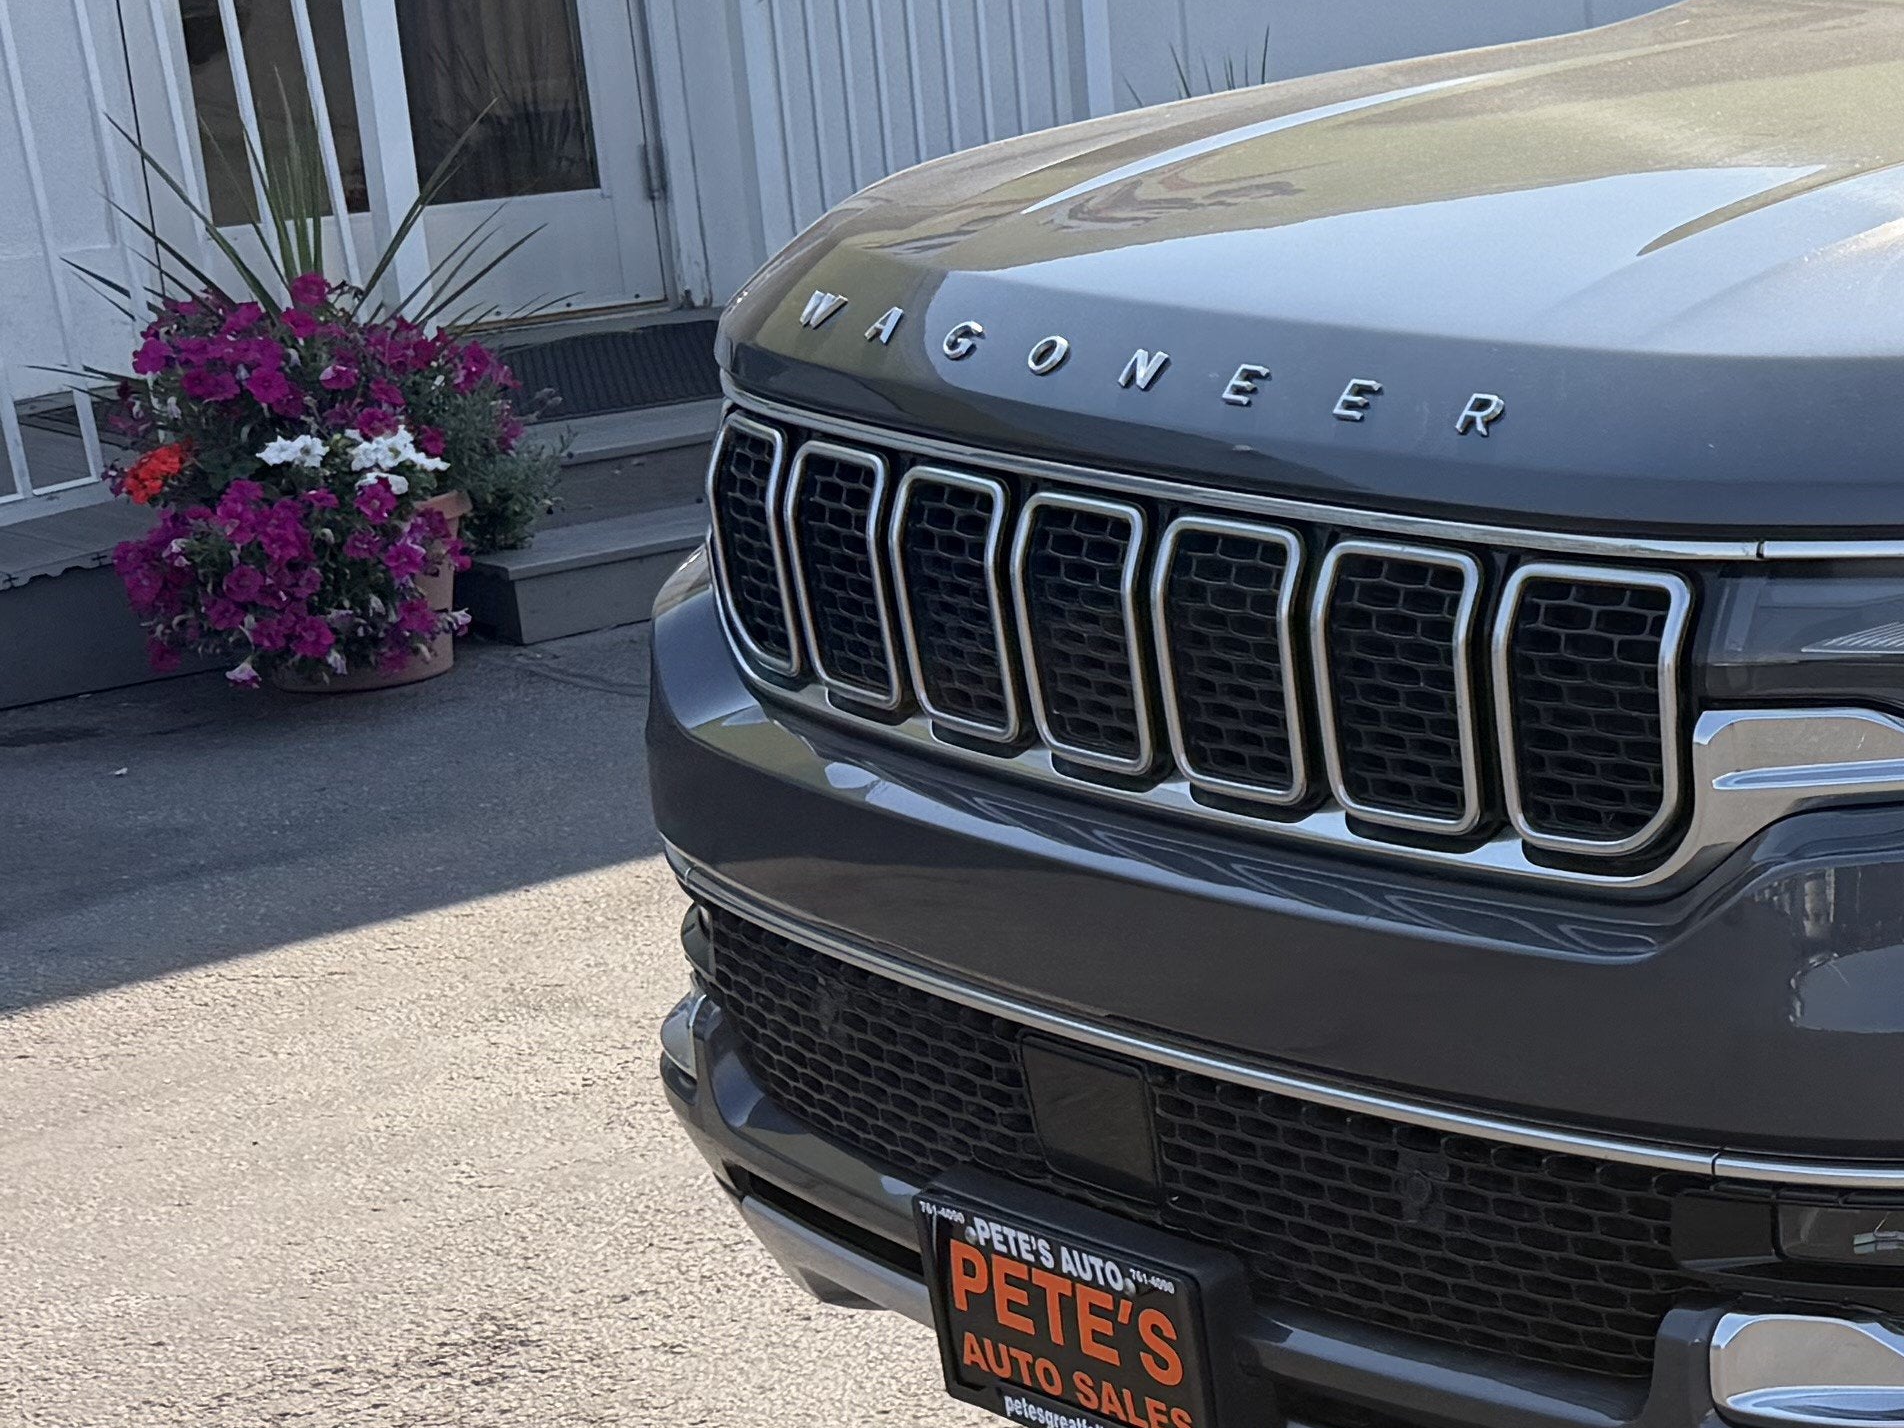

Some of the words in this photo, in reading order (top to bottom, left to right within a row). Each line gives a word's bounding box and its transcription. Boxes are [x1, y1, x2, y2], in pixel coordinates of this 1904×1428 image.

[799, 289, 1505, 437] WAGONEER
[973, 1217, 1055, 1269] PETE'S
[1060, 1246, 1124, 1292] AUTO
[950, 1238, 1184, 1387] PETE'S
[963, 1332, 1064, 1397] AUTO
